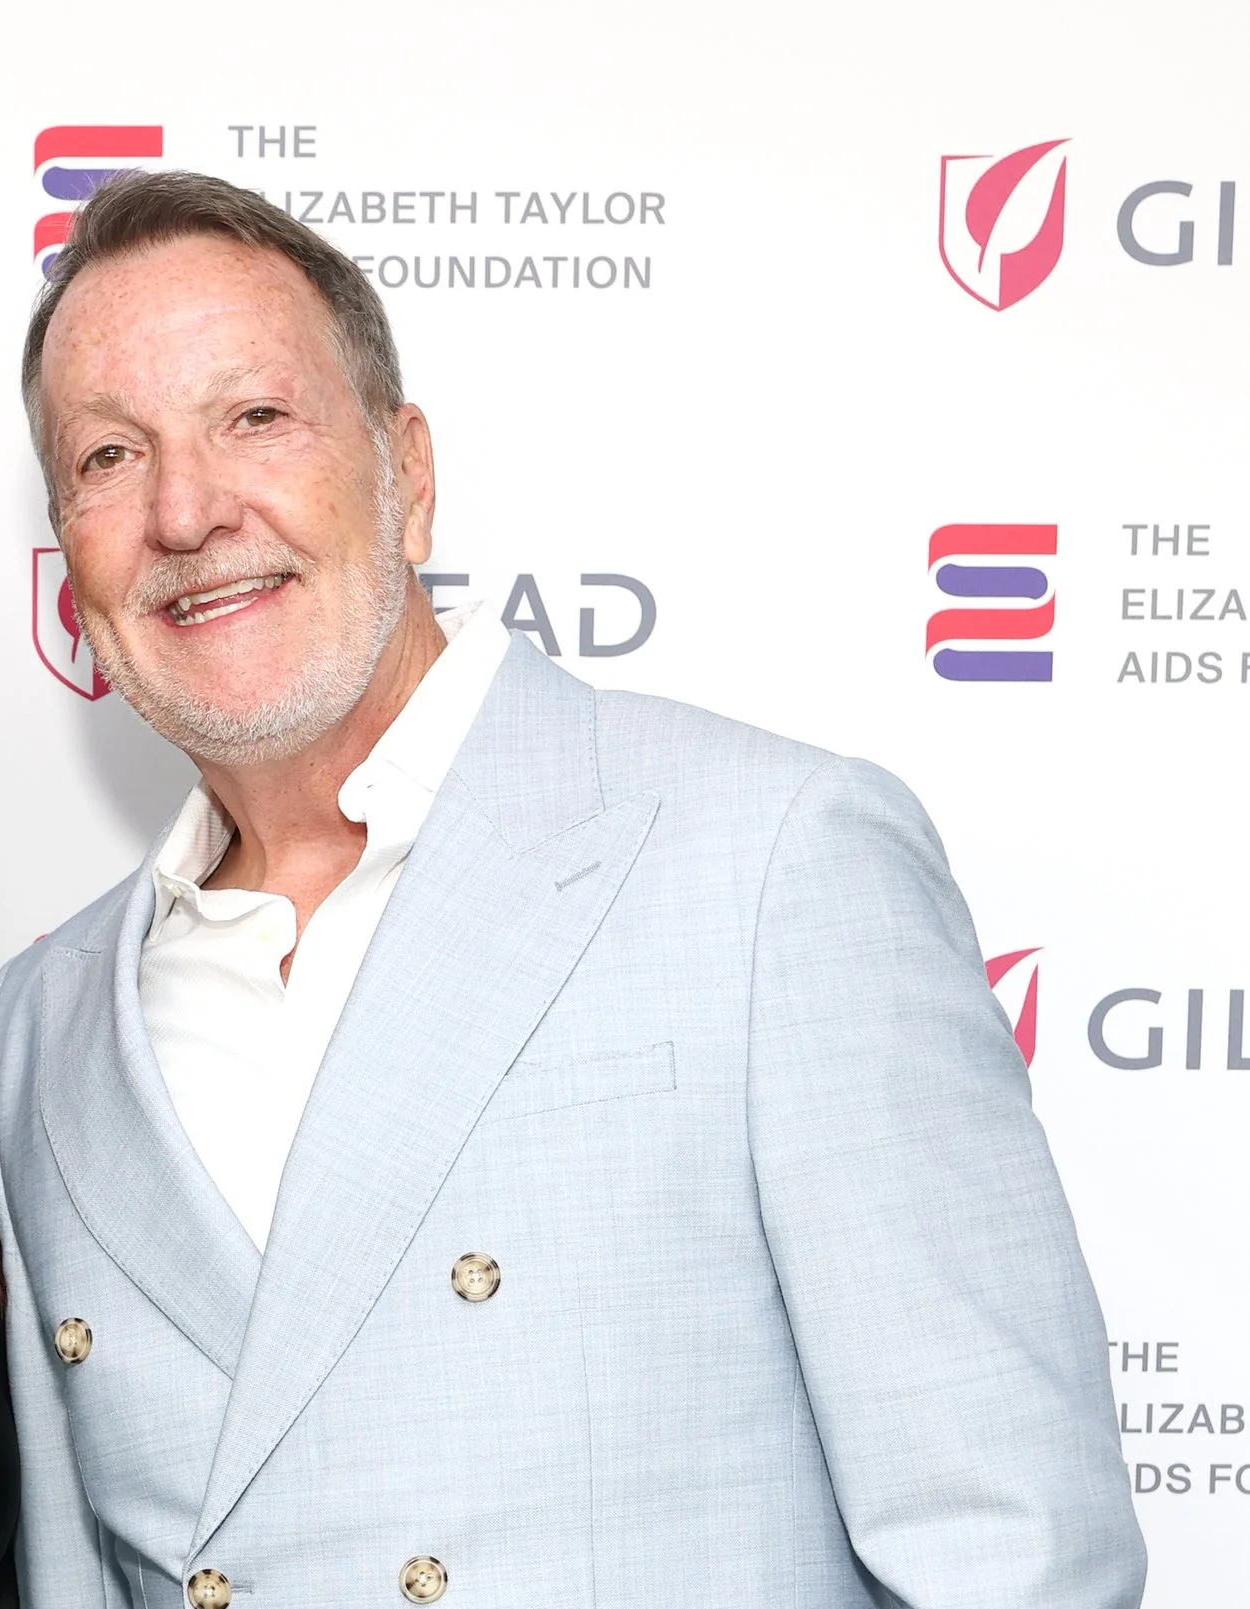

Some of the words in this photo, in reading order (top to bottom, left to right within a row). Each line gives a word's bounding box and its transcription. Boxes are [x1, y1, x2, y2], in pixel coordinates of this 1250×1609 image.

[228, 125, 317, 158] THE
[260, 191, 477, 225] IZABETH
[494, 191, 666, 225] TAYLOR
[1122, 523, 1211, 556] THE
[1121, 588, 1248, 621] ELIZA
[1116, 651, 1223, 684] AIDS
[1108, 1341, 1180, 1373] HE
[1127, 1462, 1192, 1495] DS
